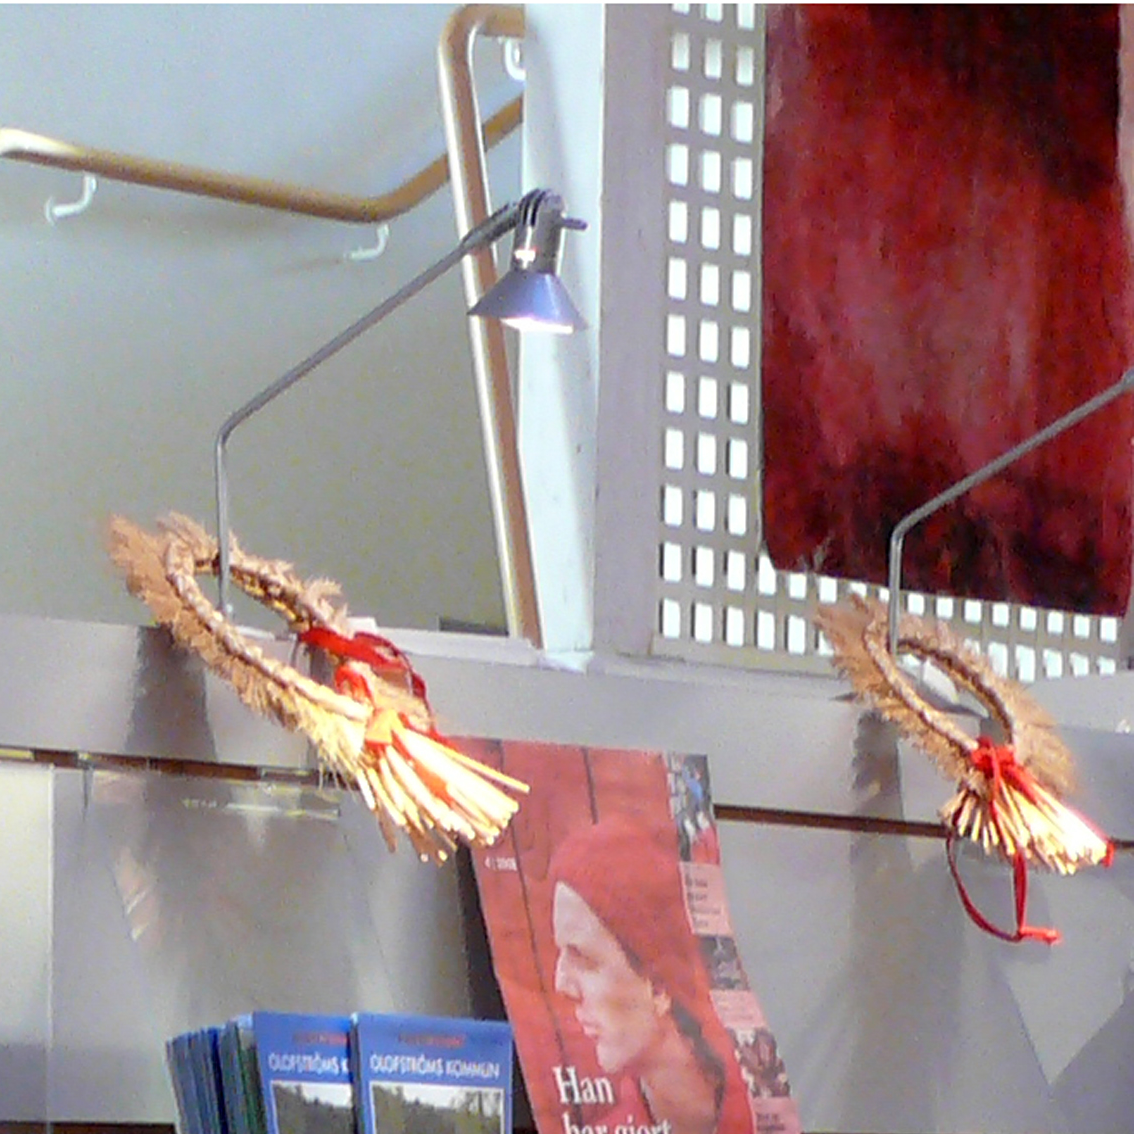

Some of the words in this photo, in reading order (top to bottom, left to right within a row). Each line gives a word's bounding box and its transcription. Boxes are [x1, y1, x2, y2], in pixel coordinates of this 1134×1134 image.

[369, 1053, 444, 1078] OLOFSTRÖMS
[445, 1057, 501, 1080] KOMMUN
[552, 1065, 615, 1105] Han
